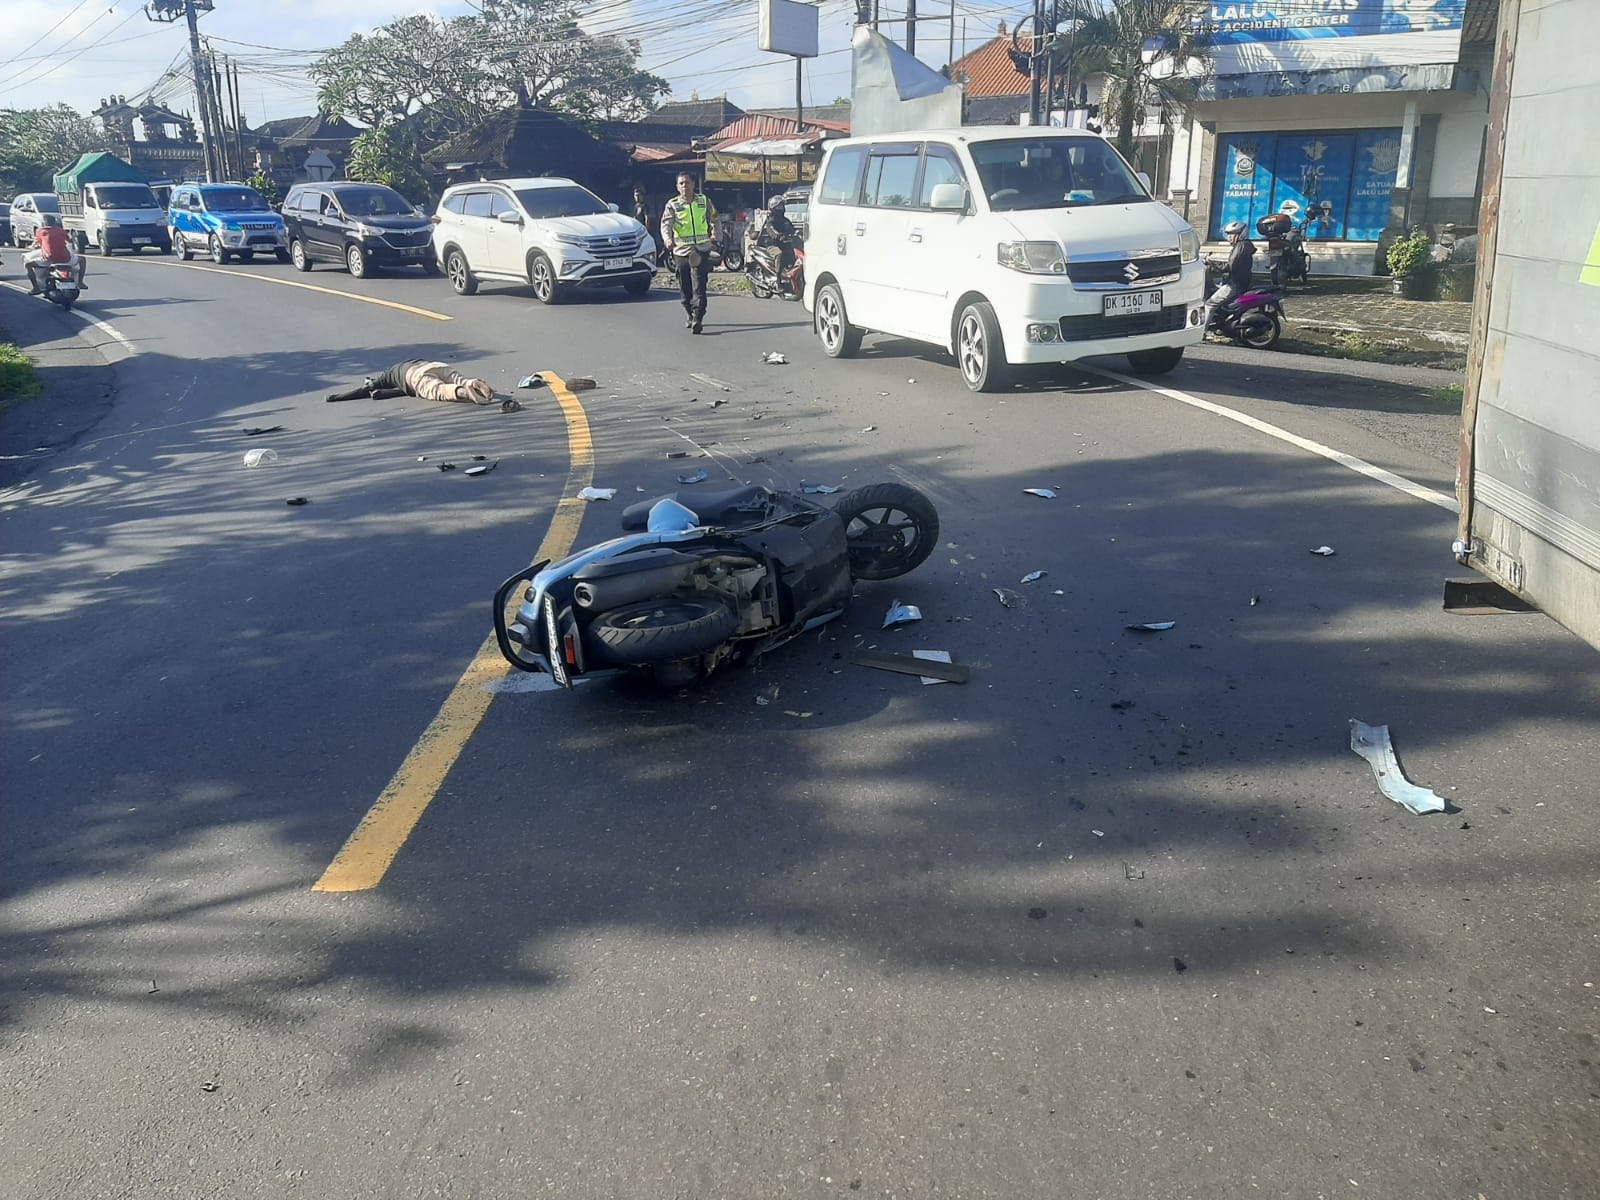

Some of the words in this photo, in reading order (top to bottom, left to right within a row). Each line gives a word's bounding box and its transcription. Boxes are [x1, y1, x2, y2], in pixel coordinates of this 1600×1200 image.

[1211, 2, 1267, 21] LALU
[1224, 18, 1290, 32] ACCIDENT
[1294, 14, 1350, 27] CENTER
[1106, 297, 1117, 309] DK
[1121, 295, 1142, 307] 1160
[1150, 293, 1160, 304] AB
